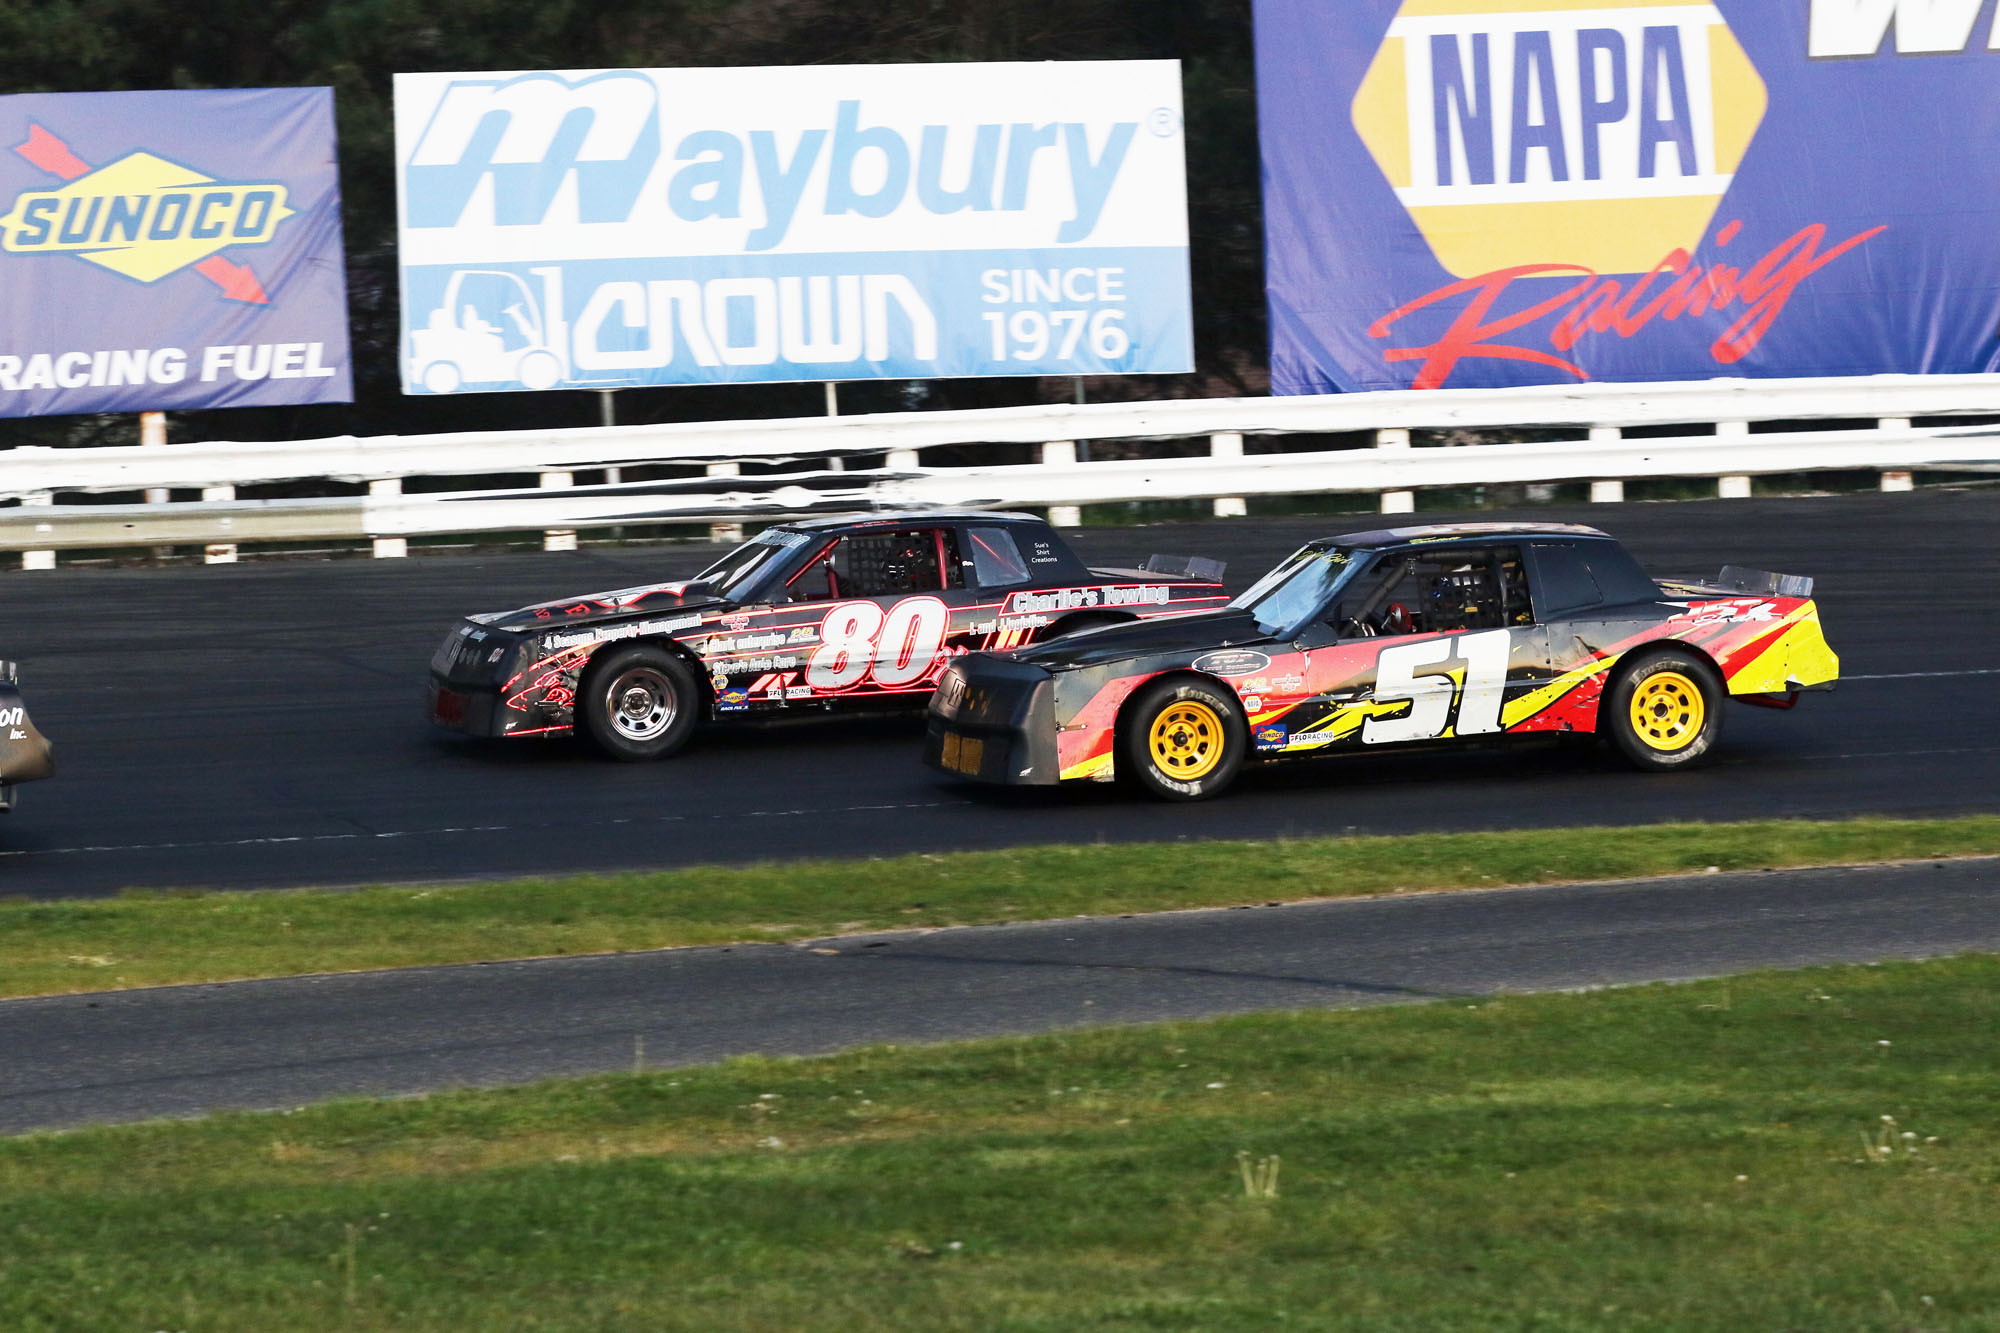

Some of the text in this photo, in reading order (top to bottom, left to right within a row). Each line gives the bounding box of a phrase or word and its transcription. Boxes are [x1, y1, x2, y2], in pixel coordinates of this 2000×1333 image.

[1429, 25, 1699, 187] NAPA
[406, 69, 1140, 252] Maybury
[15, 190, 276, 246] SUNOCO
[981, 266, 1126, 305] SINCE
[1368, 219, 1888, 391] Racing
[982, 308, 1128, 363] 1976
[0, 342, 336, 391] RACING FUEL
[1031, 556, 1058, 564] Creations
[1013, 584, 1170, 613] Charlie's Towing
[542, 633, 553, 650] 4
[553, 631, 595, 649] Seasons
[595, 623, 638, 643] Property
[639, 613, 702, 634] Management
[736, 633, 786, 650] enterprise
[978, 618, 997, 633] and
[1006, 613, 1048, 632] logistics
[805, 595, 950, 694] 80
[712, 658, 749, 676] Steve's
[1362, 629, 1511, 745] 51
[0, 705, 24, 728] on
[9, 727, 28, 740] Inc.
[1257, 732, 1285, 740] SUNOCO
